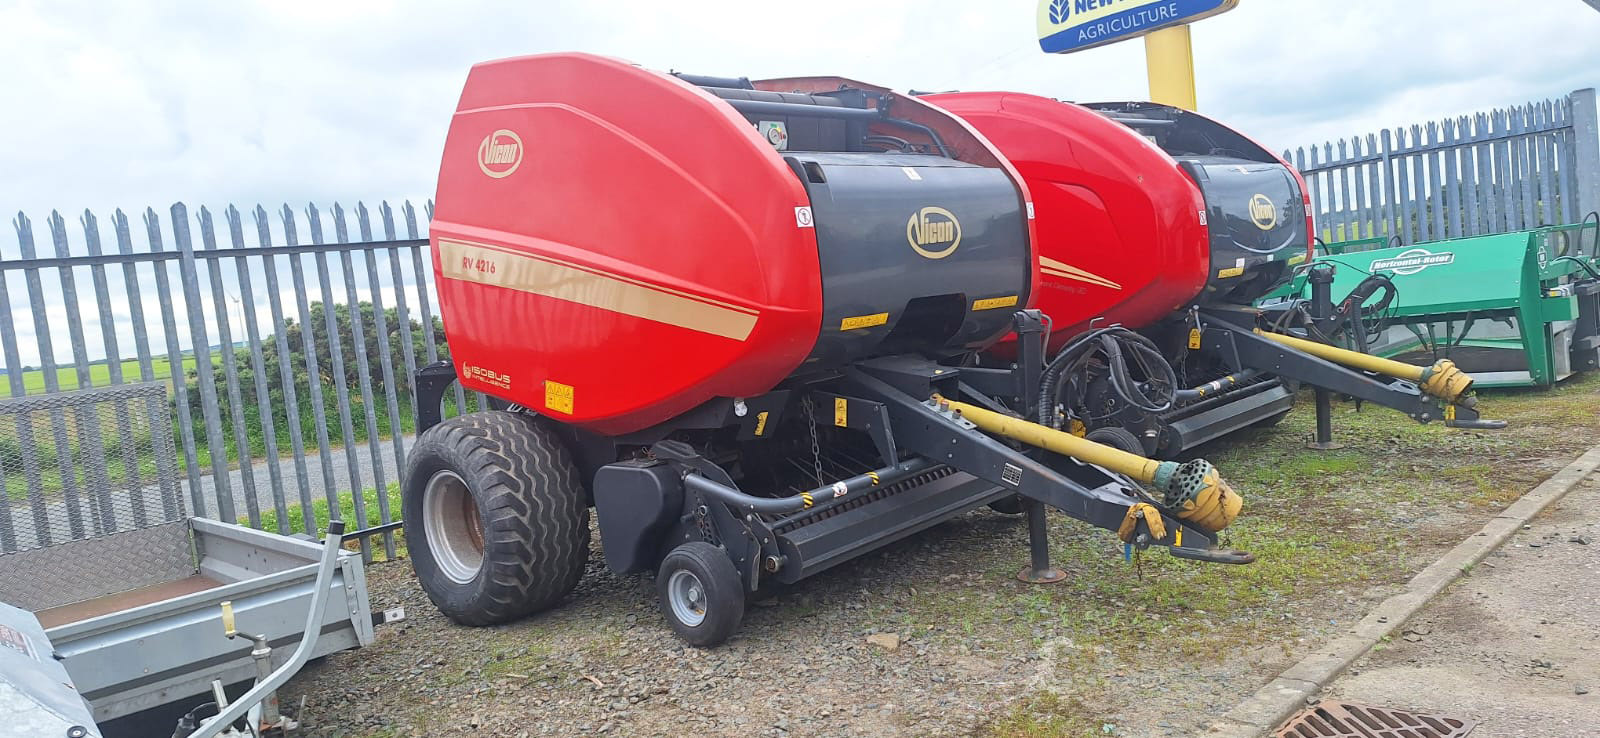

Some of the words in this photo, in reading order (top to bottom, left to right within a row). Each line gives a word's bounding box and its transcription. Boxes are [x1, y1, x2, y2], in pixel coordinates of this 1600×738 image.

[1078, 3, 1178, 42] AGRICULTURE
[463, 256, 473, 269] RV
[476, 259, 496, 274] 4216
[471, 366, 511, 384] ISOBUS
